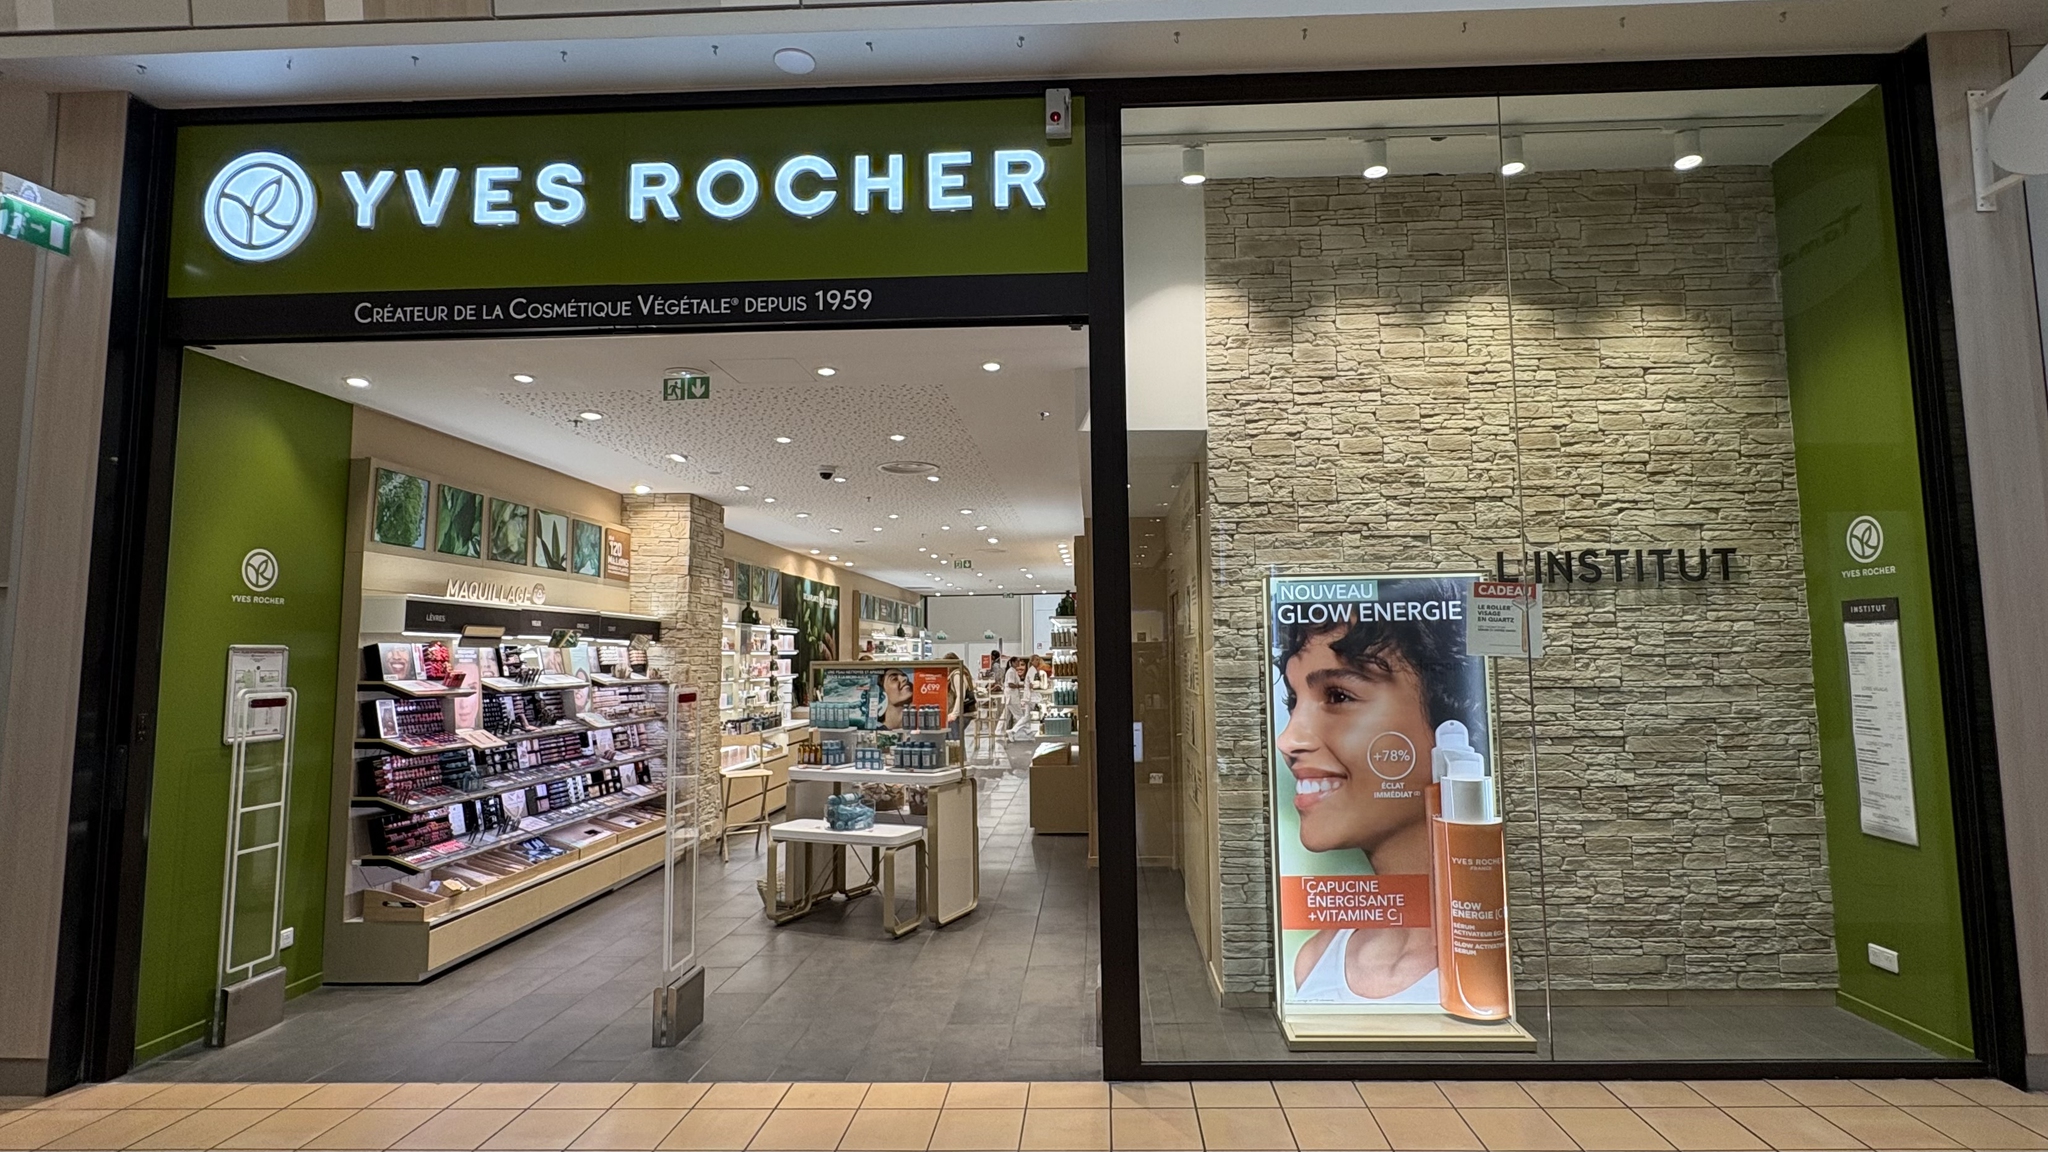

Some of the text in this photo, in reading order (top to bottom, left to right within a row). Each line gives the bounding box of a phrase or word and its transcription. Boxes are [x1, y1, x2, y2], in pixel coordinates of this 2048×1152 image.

[341, 149, 1047, 229] YVES ROCHER
[354, 302, 448, 323] CRÉATEUR
[454, 305, 476, 320] DE
[482, 303, 504, 320] LA
[509, 297, 631, 320] COSMÉTIQUE
[745, 296, 807, 313] DEPUIS
[814, 289, 873, 311] 1959
[609, 541, 622, 557] 120
[1841, 565, 1896, 578] YVES ROCHER
[446, 578, 531, 604] MAQUILLAGE
[1280, 583, 1373, 601] NOUVEAU
[1478, 584, 1532, 597] CADEAU
[231, 594, 285, 605] YVES ROCHER
[1277, 600, 1463, 625] GLOW ENERGIE
[1850, 604, 1886, 613] INSTITUT
[1373, 749, 1411, 762] +78%
[1381, 781, 1405, 790] ÉCLAT
[1451, 856, 1473, 865] YVES
[1306, 880, 1379, 893] CAPUCINE
[1307, 893, 1405, 907] ÉNERGISANTE
[1452, 899, 1482, 910] GLOW
[1308, 910, 1384, 922] +VITAMINE
[1452, 908, 1494, 920] ENERGIE
[1453, 929, 1492, 937] ACTIVATEUR
